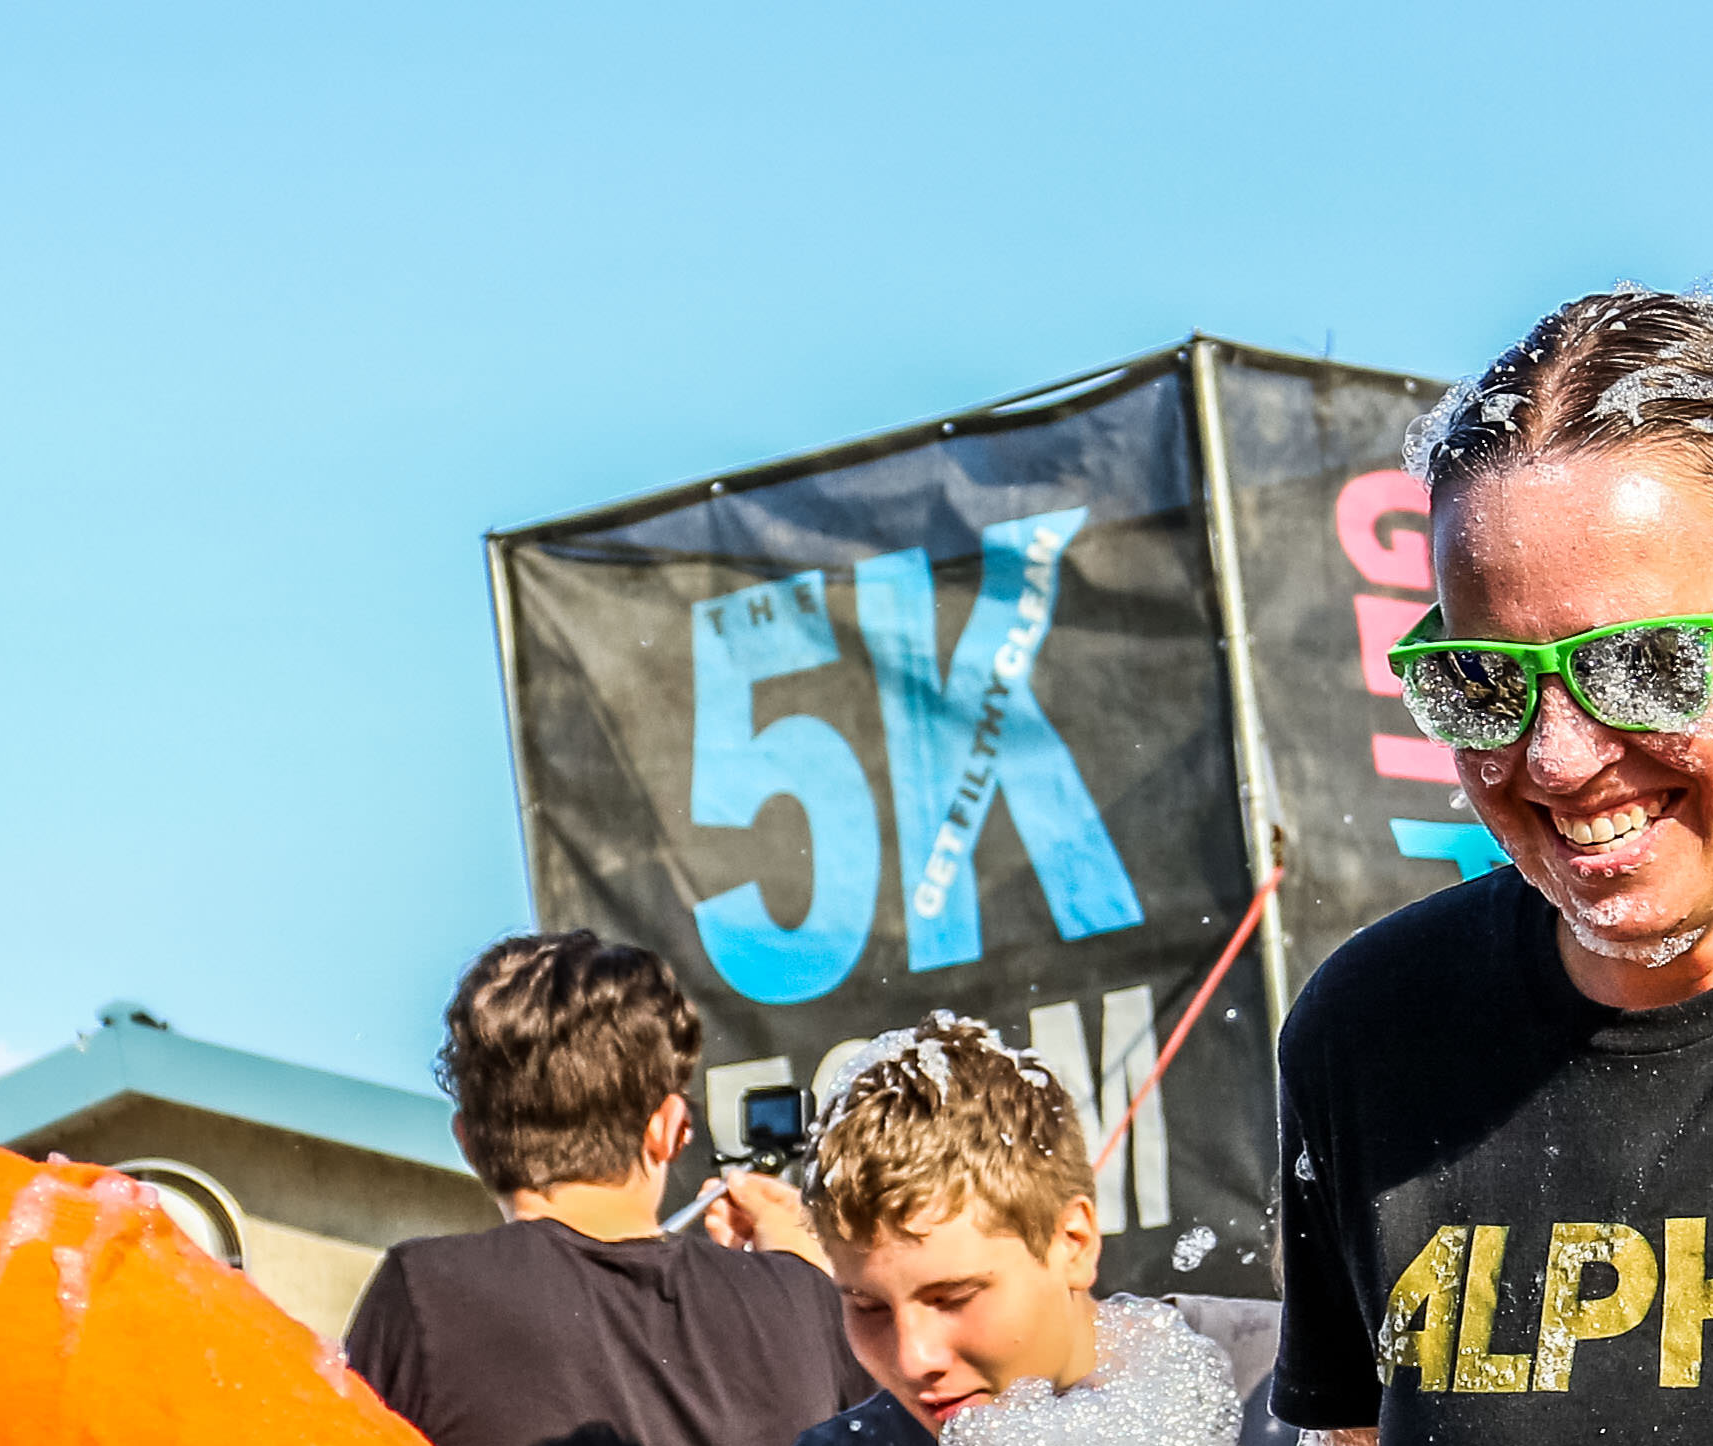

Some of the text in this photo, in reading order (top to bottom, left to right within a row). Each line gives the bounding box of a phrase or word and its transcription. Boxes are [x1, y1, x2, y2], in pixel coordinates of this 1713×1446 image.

[705, 583, 818, 635] THE
[690, 505, 1145, 1006] 5K
[706, 983, 1171, 1236] FM
